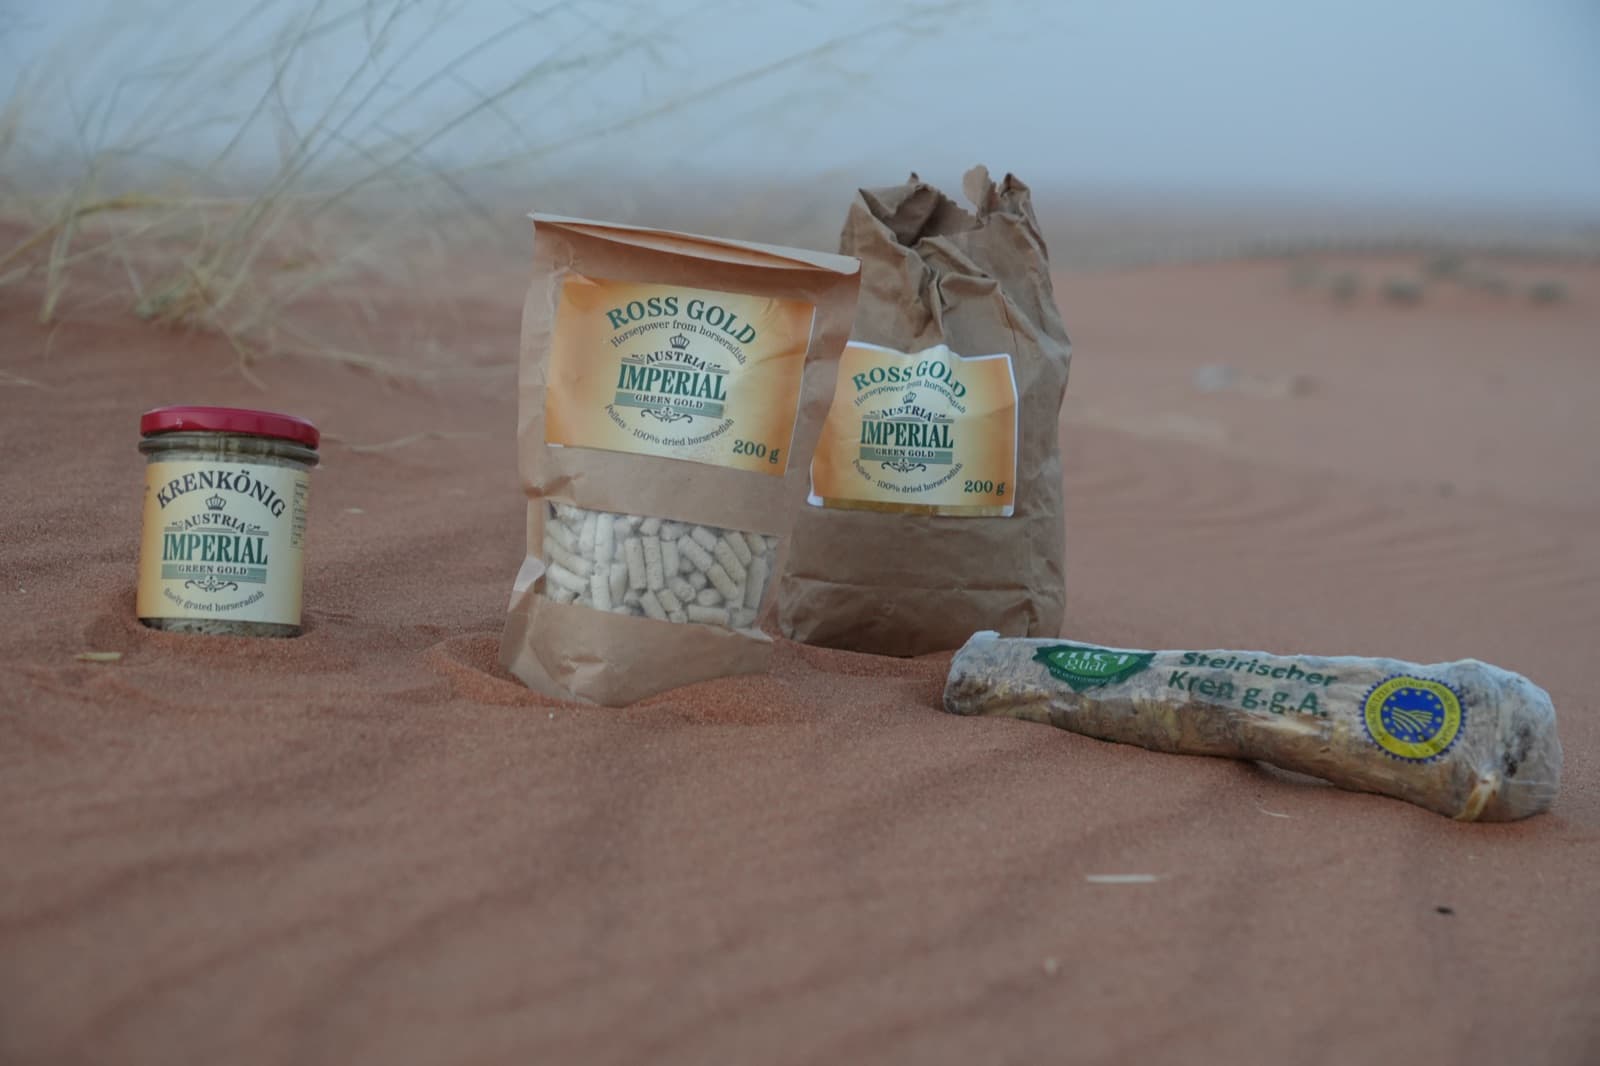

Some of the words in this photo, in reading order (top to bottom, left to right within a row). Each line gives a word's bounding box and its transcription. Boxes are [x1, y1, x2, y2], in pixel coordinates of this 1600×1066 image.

[606, 296, 679, 330] ROSS
[686, 299, 756, 345] GOLD
[611, 320, 670, 348] Horsepower
[672, 320, 697, 333] from
[699, 325, 747, 366] horseradish
[645, 350, 706, 371] AUSTRIA
[616, 364, 727, 400] IMPERIAL
[852, 366, 913, 391] ROSS
[916, 360, 966, 398] GOLD
[635, 393, 671, 405] GREEN
[673, 396, 704, 409] GOLD
[881, 404, 932, 422] AUSTRIA
[633, 428, 660, 444] 100%
[662, 437, 686, 446] dried
[687, 418, 735, 445] horseradish
[860, 421, 954, 449] IMPERIAL
[732, 439, 767, 458] 200
[769, 448, 781, 464] g
[875, 447, 906, 457] GREEN
[908, 449, 934, 458] GOLD
[877, 480, 900, 492] 100%
[902, 484, 922, 493] dried
[924, 462, 963, 492] horseradish
[964, 480, 993, 493] 200
[996, 482, 1005, 496] g
[157, 469, 286, 519] KRENKÖNIG
[184, 513, 246, 533] AUSTRIA
[162, 534, 268, 565] IMPERIAL
[178, 564, 214, 574] GREEN
[217, 566, 248, 576] GOLD
[184, 599, 212, 612] grated
[215, 591, 265, 612] horseradish
[1179, 651, 1338, 686] Steirischer
[1168, 670, 1235, 699] Kren
[1241, 687, 1328, 717] g.g.A.
